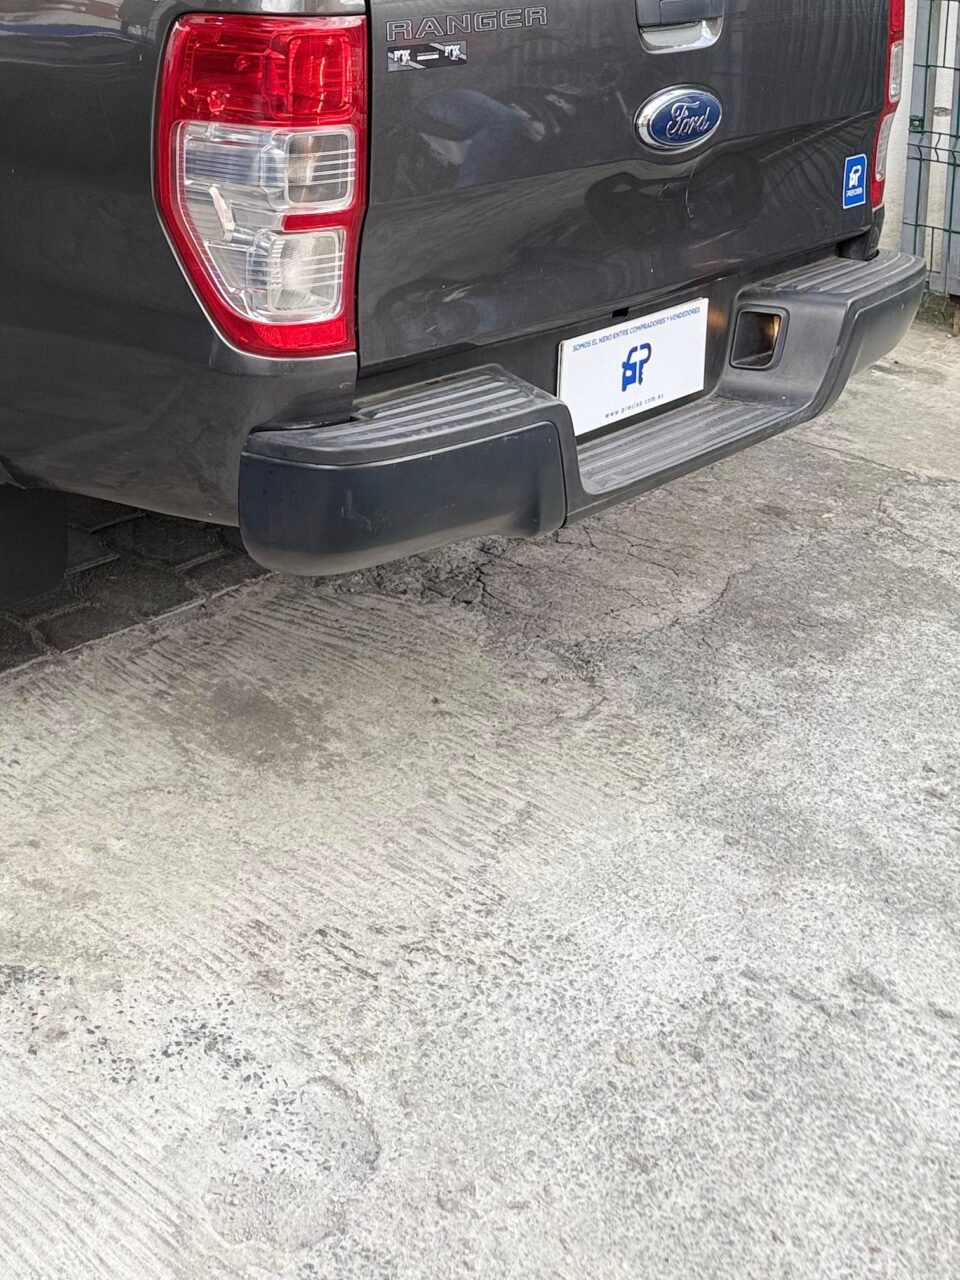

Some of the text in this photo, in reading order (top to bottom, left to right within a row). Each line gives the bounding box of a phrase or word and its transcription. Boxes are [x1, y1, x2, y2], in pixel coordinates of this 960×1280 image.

[386, 6, 548, 42] RANGER
[665, 100, 711, 139] Ford
[572, 340, 591, 352] SOMOS
[592, 338, 598, 346] EL
[613, 328, 629, 340] ENTRE
[629, 317, 666, 334] COMPRADORES
[670, 307, 701, 322] VENDEDORES
